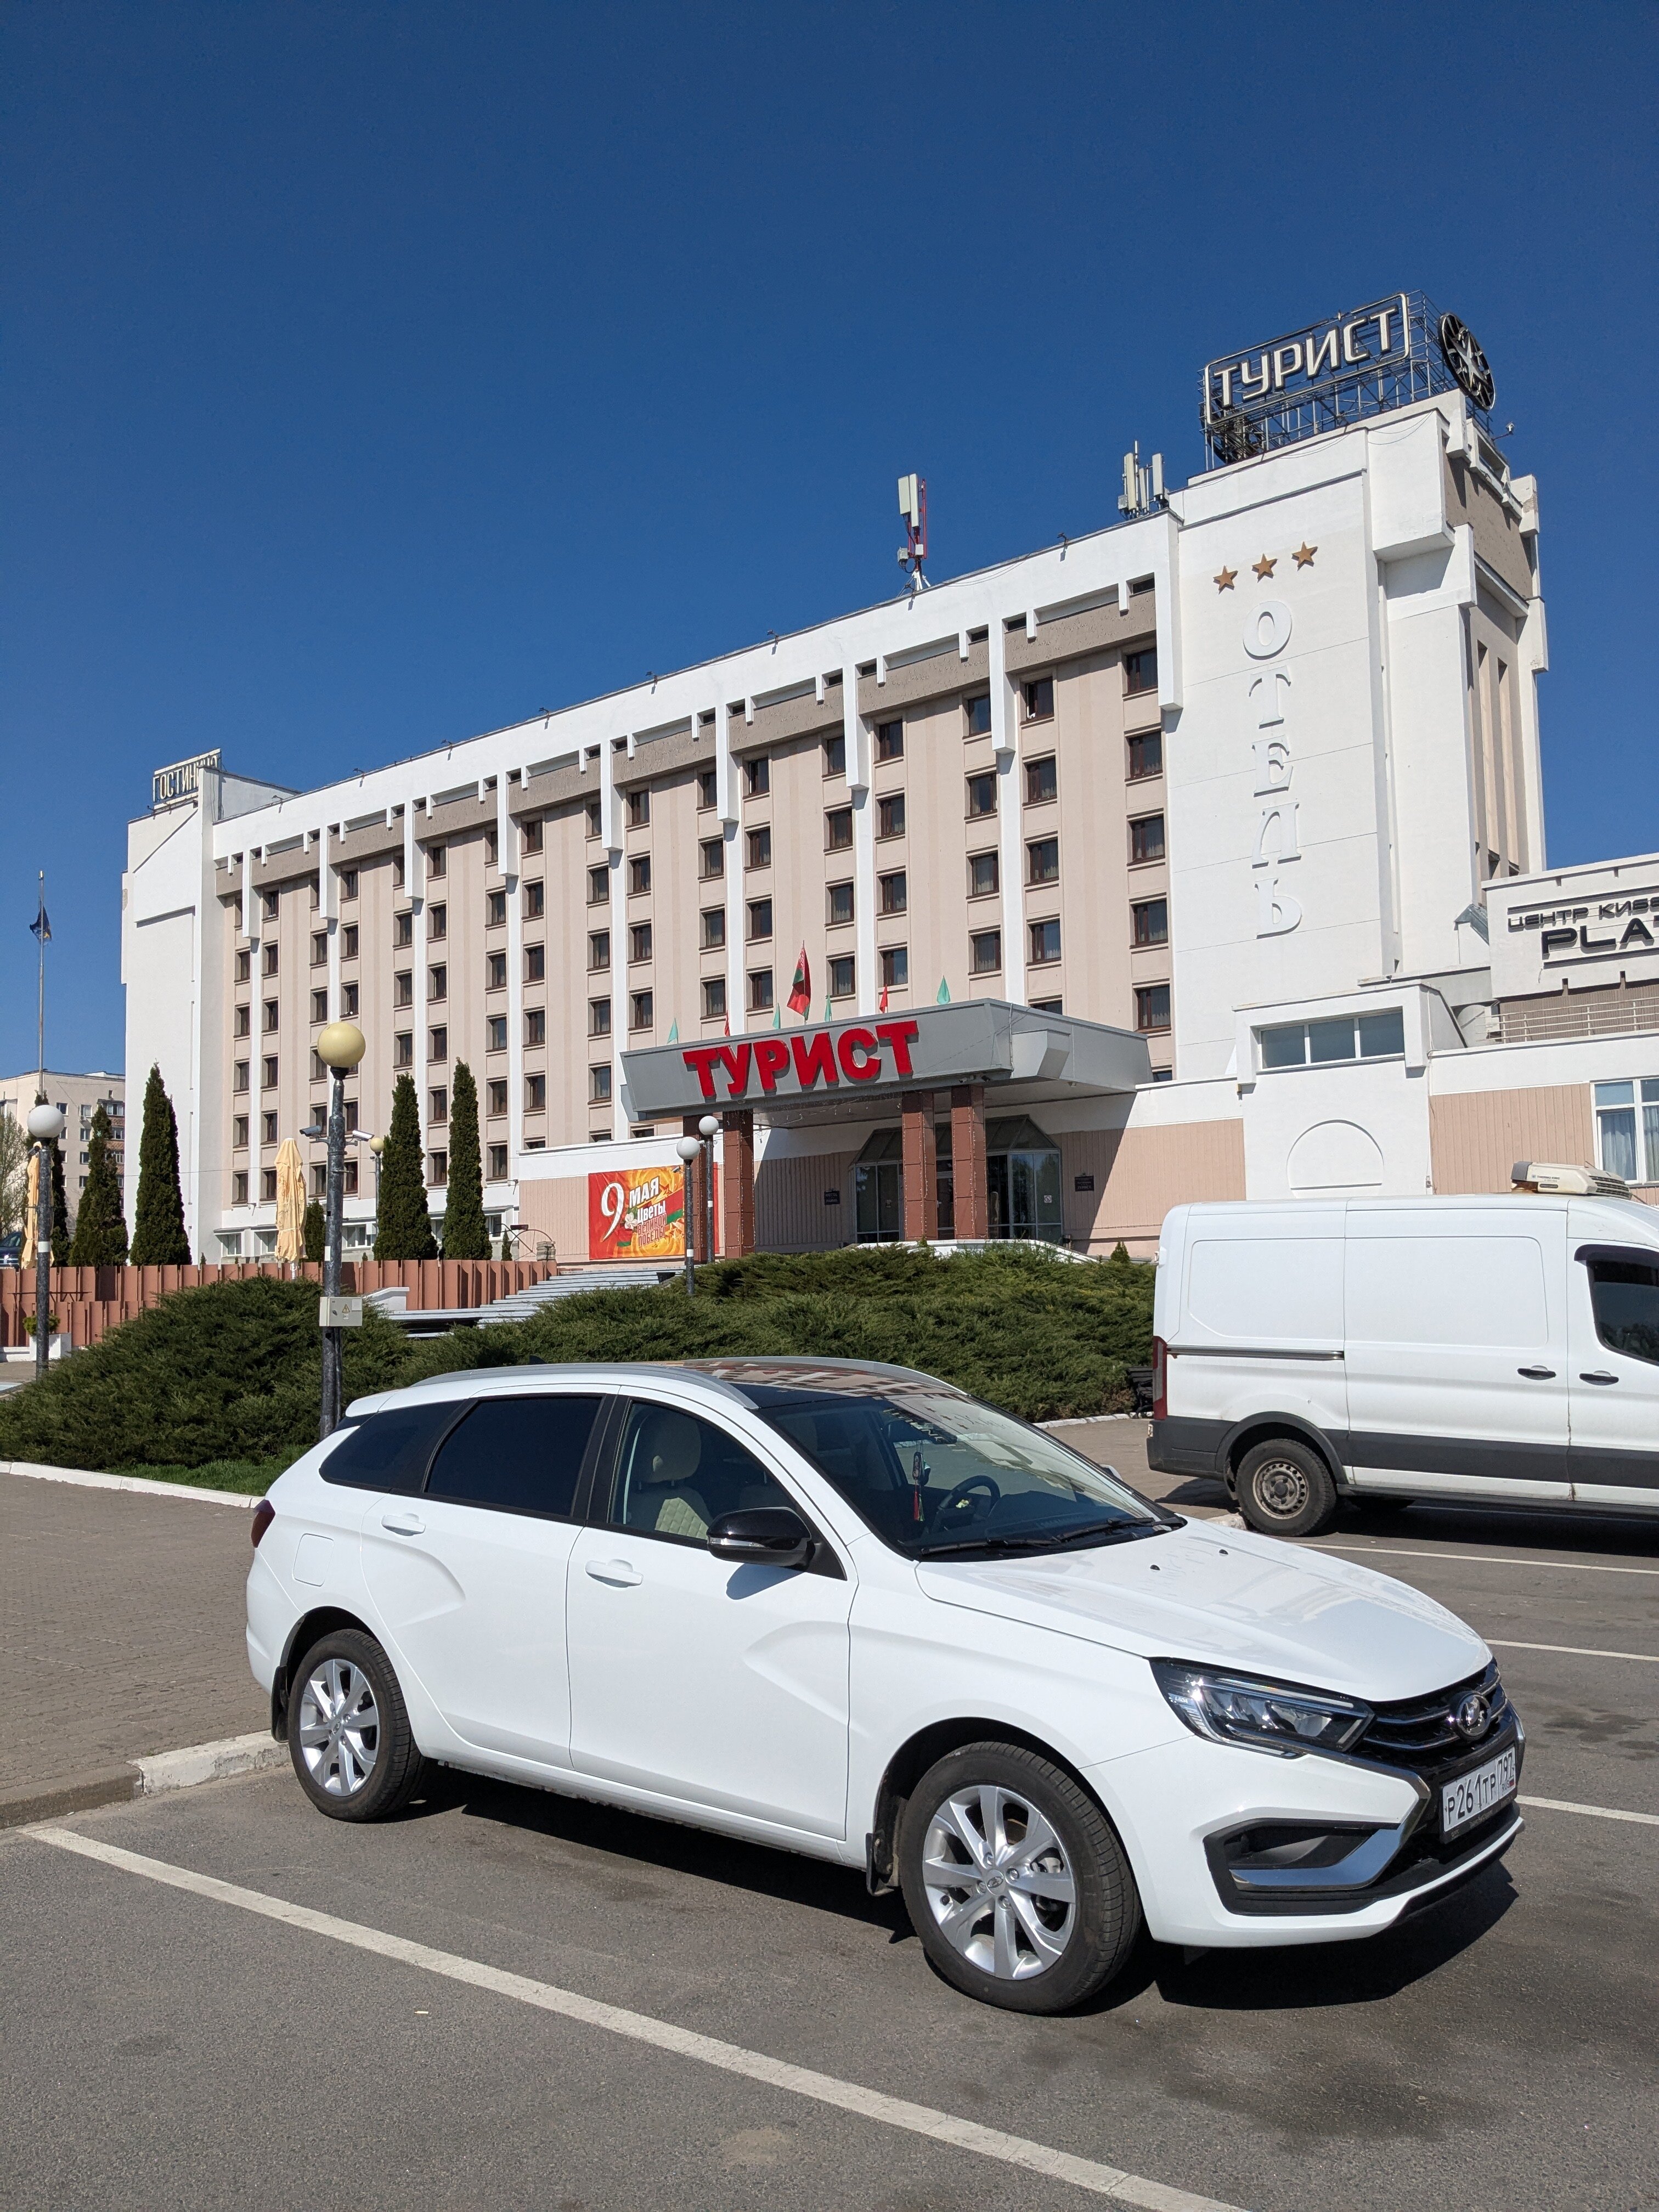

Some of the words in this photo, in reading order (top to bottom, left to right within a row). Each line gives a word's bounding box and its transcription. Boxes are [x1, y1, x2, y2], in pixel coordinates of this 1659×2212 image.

[1213, 304, 1400, 408] ТУРИСТ
[153, 755, 218, 803] ГОСТИН
[1243, 600, 1303, 939] ОТЕЛЬ
[1508, 907, 1589, 928] ЦЕНТР
[1541, 915, 1659, 957] PLA
[682, 1020, 918, 1097] ТУРИСТ
[601, 1182, 624, 1242] 9
[629, 1176, 659, 1208] МАЯ
[637, 1200, 666, 1225] Цветы
[637, 1212, 667, 1235] ВЕЛИКОЙ
[638, 1226, 666, 1247] ПОБЕДЫ
